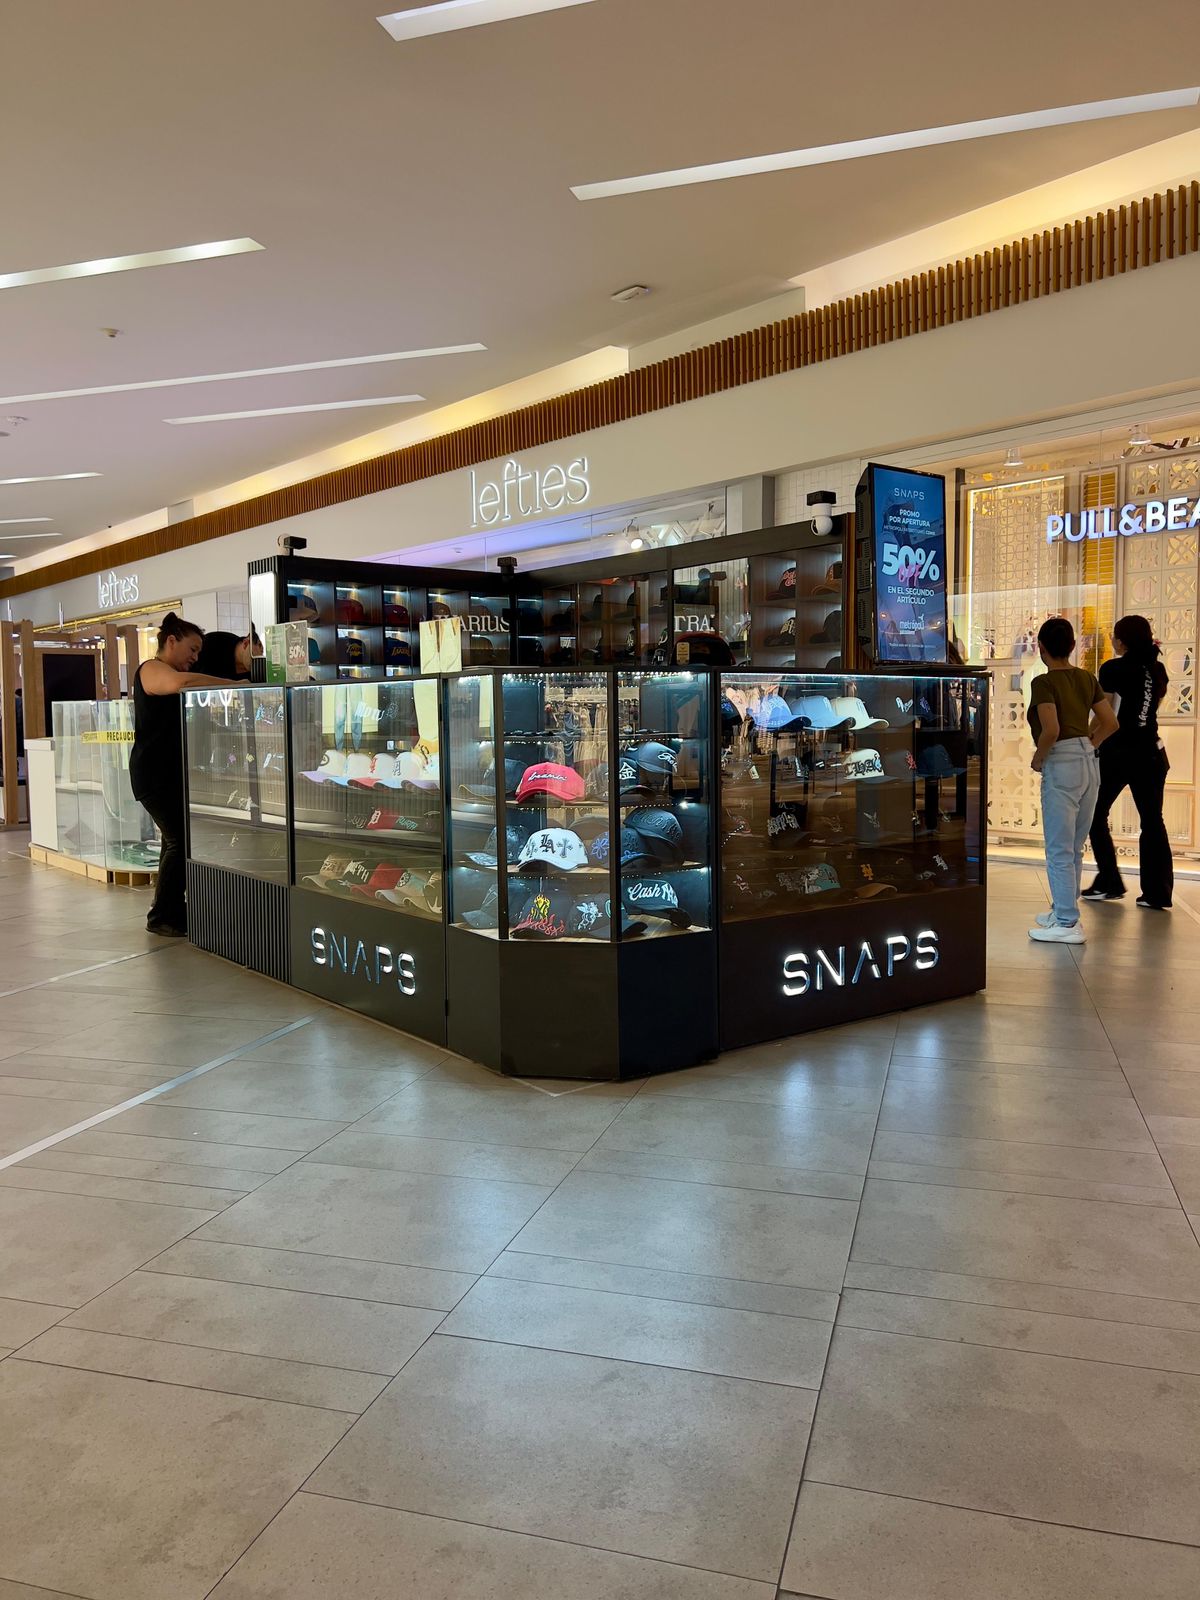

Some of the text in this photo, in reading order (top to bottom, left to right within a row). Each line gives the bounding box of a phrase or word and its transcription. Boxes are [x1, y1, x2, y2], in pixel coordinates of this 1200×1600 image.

[469, 456, 590, 529] lefties
[894, 487, 925, 501] SNAPS
[889, 515, 931, 528] POR APERTURA
[900, 509, 920, 518] PROMO
[881, 543, 940, 581] 50%
[97, 570, 139, 609] lefties
[888, 586, 935, 597] EN EL SEGUNDO
[434, 614, 510, 633] ARIUS
[674, 614, 715, 632] TRA
[289, 645, 305, 659] 50%
[627, 882, 661, 901] Cash
[311, 927, 416, 996] SNAPS
[782, 930, 940, 996] SNAPS
